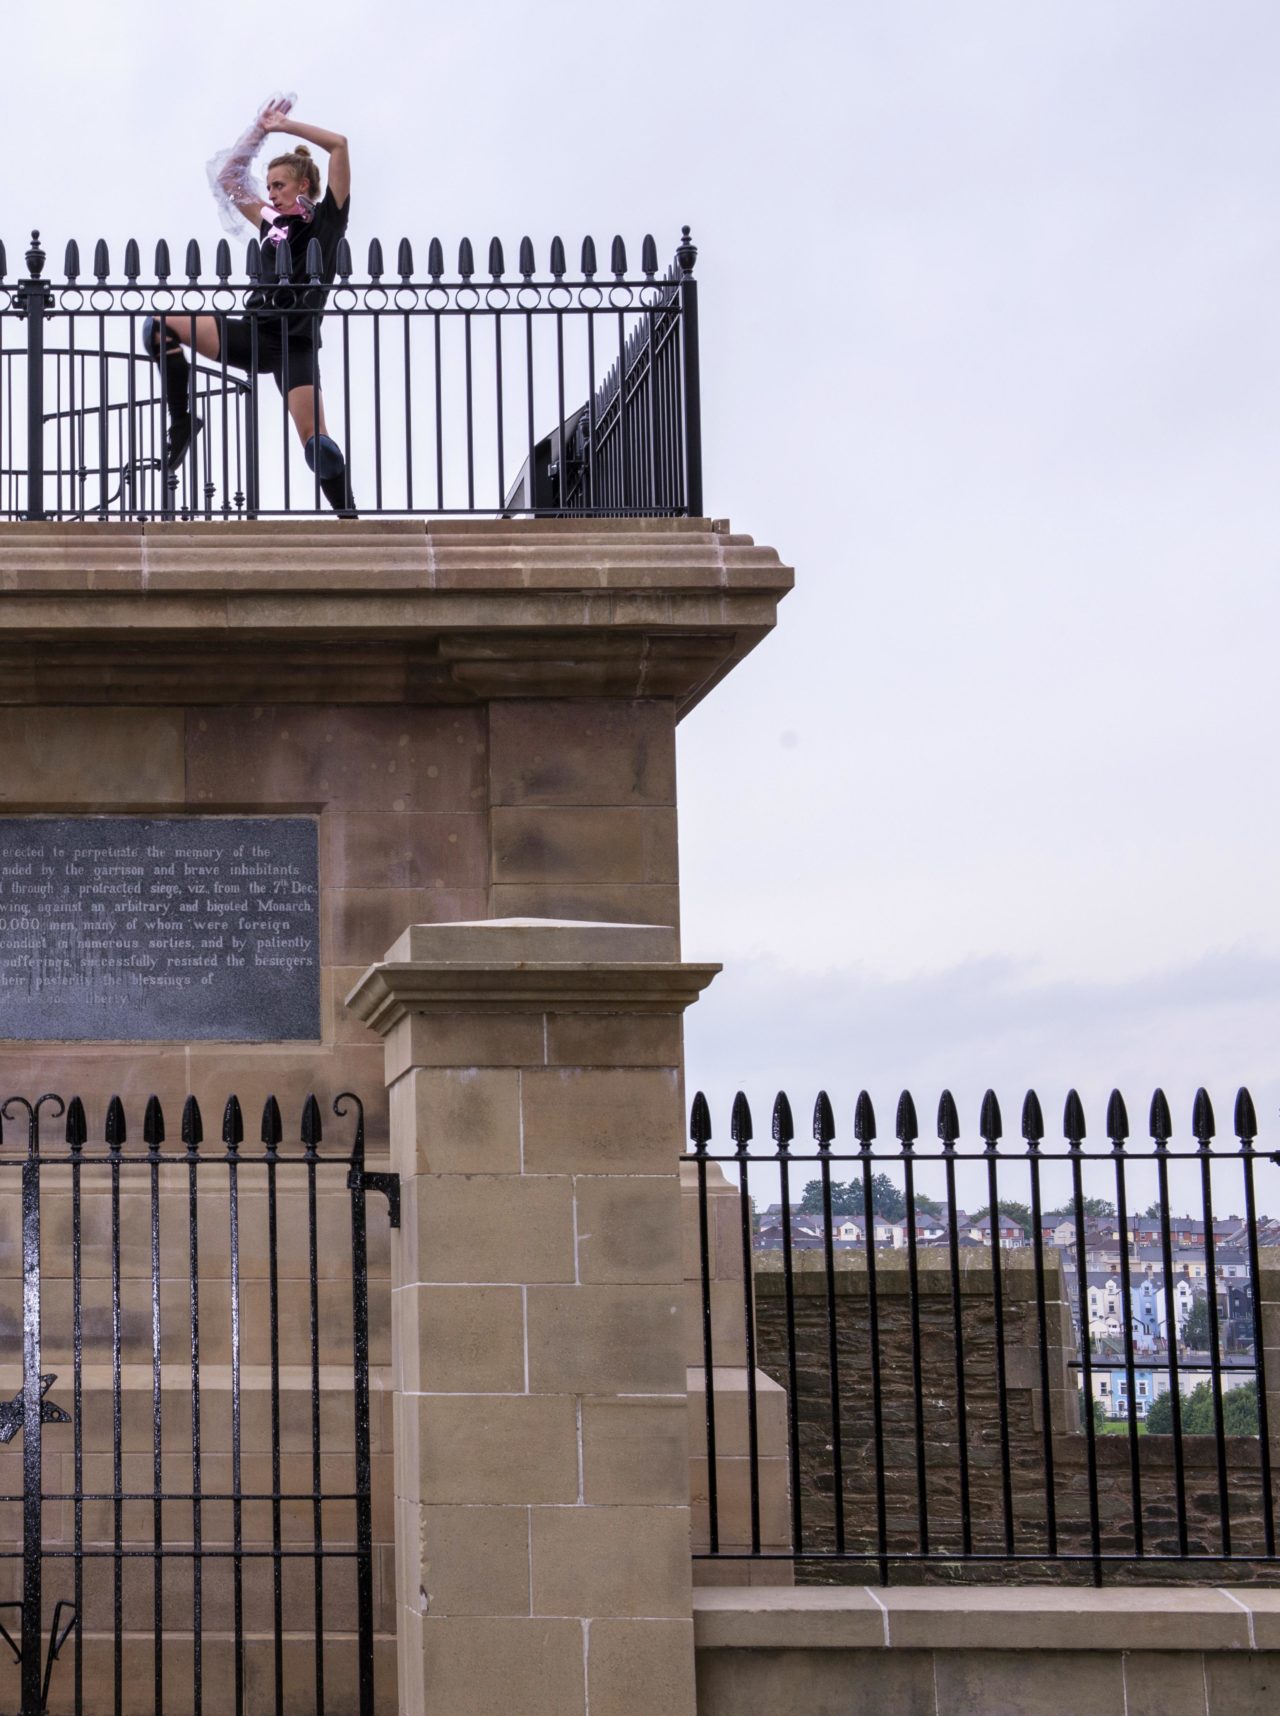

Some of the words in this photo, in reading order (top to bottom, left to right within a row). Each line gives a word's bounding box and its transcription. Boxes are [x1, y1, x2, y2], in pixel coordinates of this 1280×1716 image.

[2, 845, 45, 857] erected
[53, 845, 65, 857] to
[147, 845, 166, 857] the
[175, 848, 224, 862] memory
[233, 844, 245, 857] of
[252, 844, 270, 857] the
[2, 862, 32, 876] aided
[41, 863, 55, 879] by
[65, 863, 84, 876] the
[94, 864, 144, 881] garrison
[154, 862, 175, 876] and
[184, 862, 220, 876] brave
[230, 862, 300, 876] inhabitants
[11, 881, 54, 899] through
[63, 885, 70, 894] a
[79, 881, 141, 898] protracted
[214, 881, 240, 894] from
[249, 881, 266, 894] the
[38, 901, 82, 917] against
[91, 902, 105, 912] an
[114, 900, 170, 916] arbitrary
[179, 900, 198, 912] and
[207, 900, 248, 916] bigoted
[84, 921, 117, 934] many
[126, 918, 137, 930] of
[145, 918, 183, 930] whom
[194, 920, 228, 930] were
[239, 917, 290, 934] foreign
[0, 937, 47, 949] conduct
[77, 939, 139, 949] numerous
[201, 936, 223, 948] and
[232, 936, 246, 952] by
[257, 936, 312, 952] patiently
[81, 954, 158, 971] successfully
[167, 954, 218, 967] resisted
[226, 954, 245, 967] the
[255, 954, 313, 971] besiegers
[132, 972, 191, 990] blessings
[201, 972, 214, 985] of
